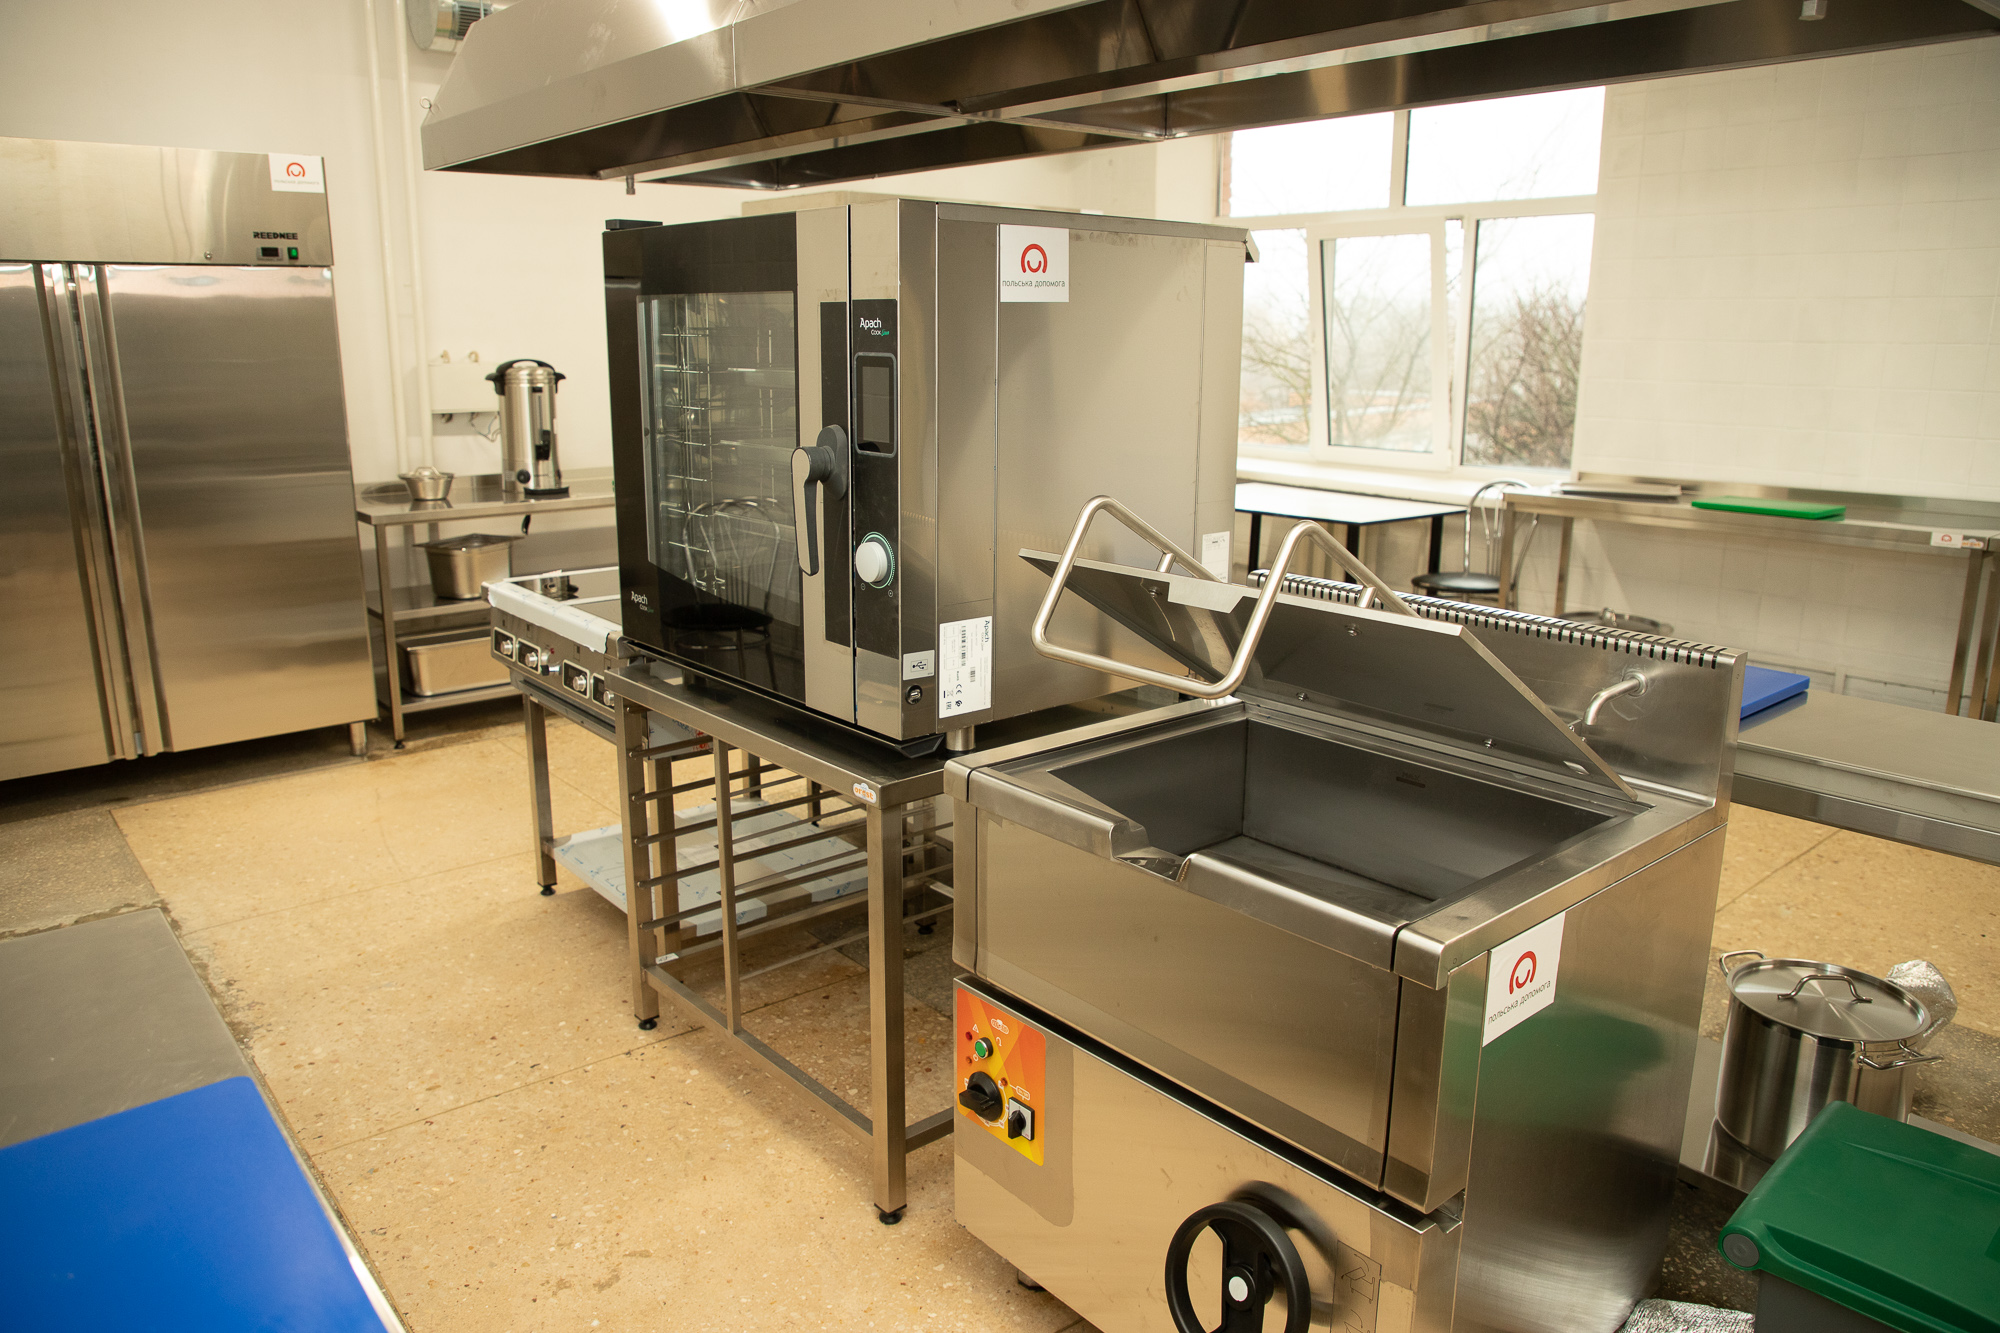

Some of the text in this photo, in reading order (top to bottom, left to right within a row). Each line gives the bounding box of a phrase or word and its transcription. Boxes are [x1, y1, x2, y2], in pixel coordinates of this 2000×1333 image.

[252, 231, 298, 240] REEDNEE
[1034, 280, 1066, 288] допомога
[859, 317, 882, 330] Apach
[630, 590, 648, 605] Apach
[854, 786, 874, 800] orest
[1488, 980, 1551, 1025] польська допомога
